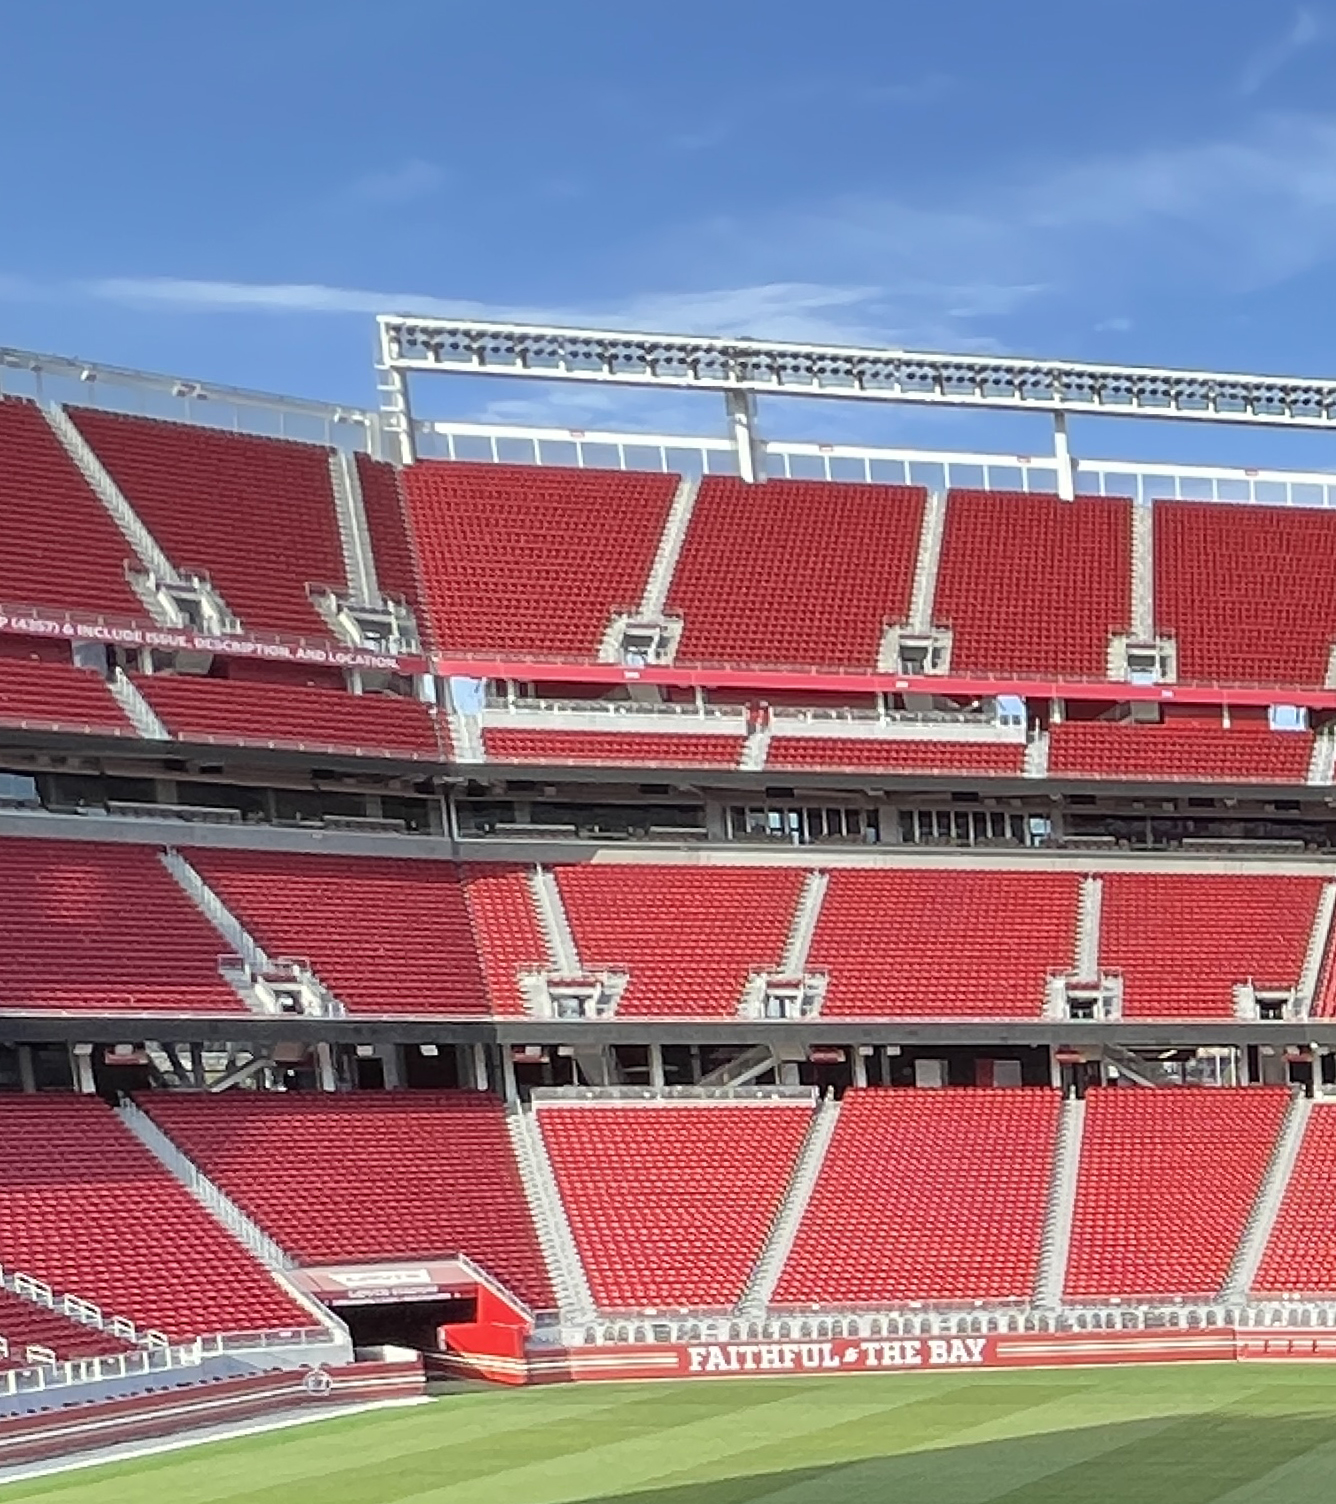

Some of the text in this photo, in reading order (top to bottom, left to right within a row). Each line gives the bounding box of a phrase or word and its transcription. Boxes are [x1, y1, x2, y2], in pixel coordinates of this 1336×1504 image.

[78, 625, 142, 643] INCLUDE
[296, 649, 326, 661] AND
[688, 1345, 839, 1371] FAITHFUL
[862, 1341, 922, 1365] THE
[929, 1339, 987, 1363] BAY
